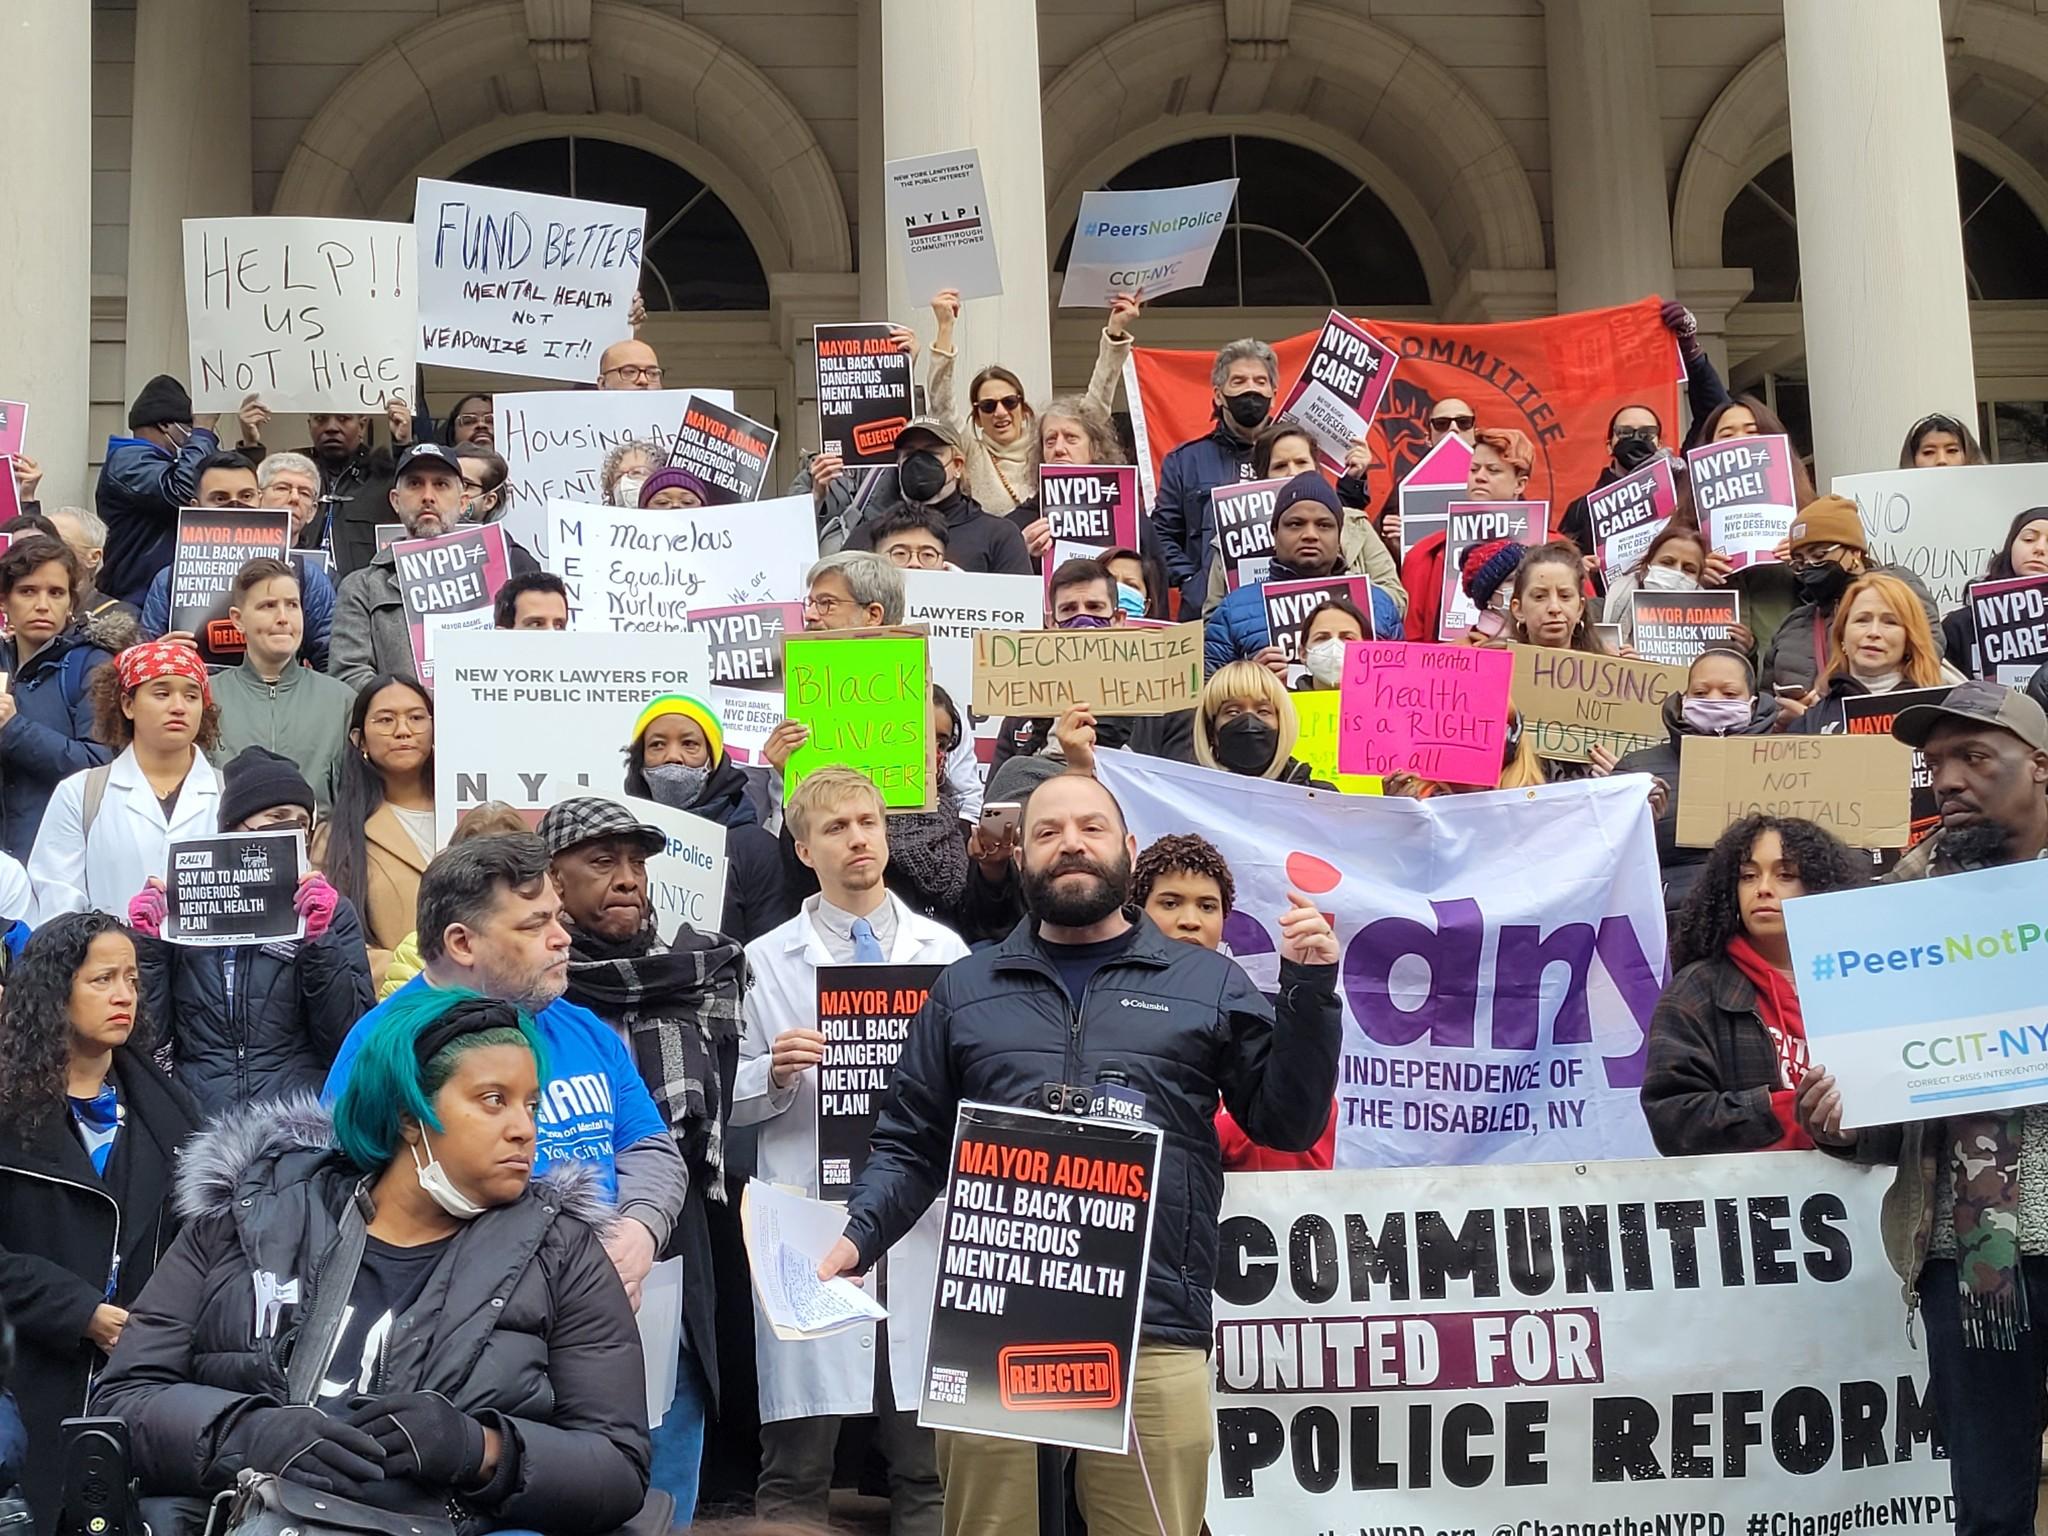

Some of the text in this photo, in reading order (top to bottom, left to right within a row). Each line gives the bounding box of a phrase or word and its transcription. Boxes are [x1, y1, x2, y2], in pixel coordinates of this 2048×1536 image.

[894, 174, 909, 182] NEW
[910, 171, 928, 179] YORK
[929, 165, 960, 176] LAWYERS
[915, 176, 939, 186] PUBLIC
[939, 171, 970, 181] INTEREST
[434, 202, 644, 271] FUND BETTER
[910, 228, 983, 246] JUSTICE THROUGH
[1084, 209, 1223, 239] #PeersNotPolice
[911, 235, 984, 253] COMMUNITY POWER
[202, 231, 402, 310] HELP!!
[1109, 261, 1183, 287] CCIT-NYC
[463, 279, 613, 308] MENTAL HEALTH
[512, 311, 554, 325] NOT
[542, 339, 593, 360] IT!!
[819, 340, 862, 357] MAYOR
[200, 348, 282, 393] NOT
[819, 355, 905, 372] ROLL BACK YOUR
[1311, 352, 1365, 400] CARE!
[820, 370, 882, 386] DANGEROUS
[821, 384, 905, 400] MENTAL HEALTH
[822, 401, 853, 415] PLAN!
[684, 409, 728, 440] MAYOR
[860, 425, 903, 447] REJECTE
[675, 440, 737, 475] DANGEROUS
[680, 425, 761, 472] ROLL BACK YOUR
[670, 455, 752, 499] MENTAL HEALTH
[1700, 471, 1764, 510] CARE!
[1047, 509, 1110, 539] CARE!
[1599, 499, 1653, 539] CARE!
[1724, 519, 1788, 533] NYC DESERVES
[1854, 490, 1911, 538] NO
[181, 527, 231, 544] MAYOR
[180, 545, 211, 560] ROLL
[212, 545, 244, 560] BACK
[178, 561, 243, 576] DANGEROU
[609, 559, 706, 597] Equality
[177, 577, 226, 592] MENTAL
[409, 571, 482, 613] CARE!
[175, 593, 211, 608] PLAN!
[606, 591, 686, 620] Nurture
[910, 605, 1025, 624] LAWYERS FOR
[1637, 608, 1683, 624] MAYOR
[1637, 625, 1666, 640] ROLL
[1667, 625, 1699, 640] BACK
[1984, 624, 2048, 663] CARE
[1638, 641, 1706, 656] DANGEROUS
[455, 668, 689, 685] NEW YORK LAWYERS FOR
[1354, 643, 1480, 685] good mental
[1534, 652, 1673, 706] HOUSING
[471, 687, 581, 703] THE PUBLIC
[725, 698, 747, 710] MAYOR
[987, 680, 1085, 707] MENTAL
[1374, 672, 1470, 713] health
[723, 708, 744, 721] NYC
[1575, 698, 1622, 725] NOT
[1343, 711, 1362, 732] is
[1376, 718, 1394, 734] a
[1408, 711, 1496, 745] RIGHT
[1366, 739, 1401, 774] for
[1408, 749, 1441, 773] all
[1753, 739, 1823, 765] HOMES
[1763, 772, 1812, 792] NOT
[178, 854, 207, 866] RALLY
[177, 869, 199, 886] SAY
[200, 871, 215, 885] NO
[217, 870, 231, 885] TO
[178, 885, 241, 901] DANGEROUS
[179, 898, 265, 916] MENTAL HEALTH
[180, 916, 208, 930] PLAN
[1811, 923, 2048, 982] #PeersNotP
[821, 990, 888, 1016] MAYOR
[1129, 999, 1170, 1012] Columbia
[821, 1018, 910, 1042] ROLL BACK
[821, 1043, 902, 1066] DANGERO
[1902, 1023, 2048, 1070] CCIT-NY
[821, 1068, 888, 1091] MENTAL
[1343, 1054, 1584, 1093] INDEPENDENCE OF
[1906, 1072, 1983, 1089] CORRECT CRISIS
[821, 1093, 870, 1116] PLAN!
[1342, 1096, 1586, 1137] THE DISABLED, NY
[958, 1140, 1150, 1203] MAYOR ADAMS,
[954, 1179, 1136, 1232] ROLL BACK YOUR
[949, 1211, 1081, 1258] DANGEROUS
[1212, 1192, 1853, 1306] COMMUNITIES
[945, 1245, 1125, 1299] MENTAL HEALTH
[940, 1278, 1006, 1316] PLAN!
[1222, 1313, 1597, 1390] UNITED FOR
[930, 1380, 967, 1394] POLICE
[1009, 1362, 1110, 1395] REJECTED
[929, 1391, 967, 1405] REFORM
[1218, 1374, 1952, 1499] POLICE REFORM
